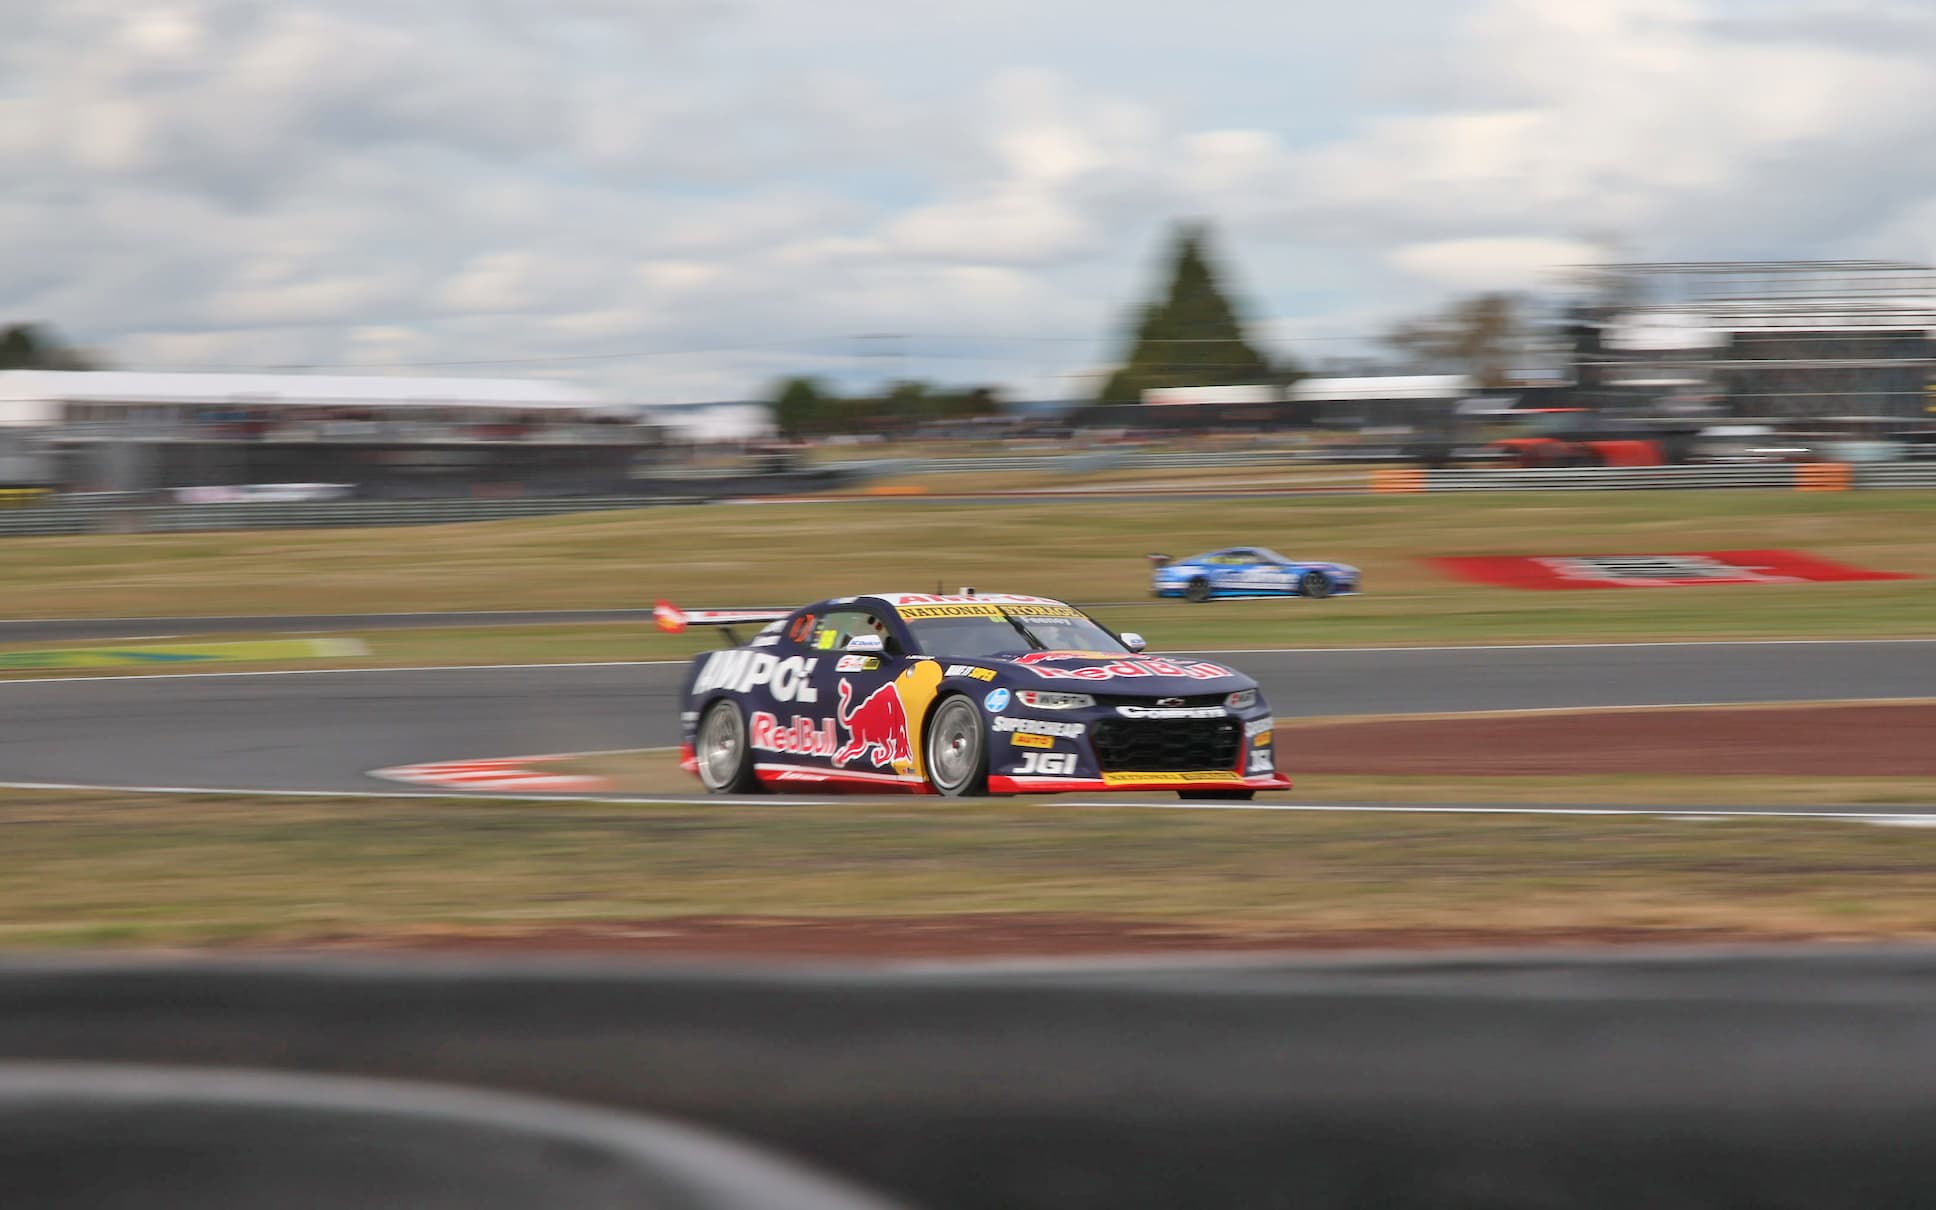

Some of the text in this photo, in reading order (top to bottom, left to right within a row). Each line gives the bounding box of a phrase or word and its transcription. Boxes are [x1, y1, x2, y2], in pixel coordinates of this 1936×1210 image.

[901, 605, 996, 618] NATIONAL
[691, 650, 818, 703] AMPOL
[1012, 751, 1078, 775] JGI
